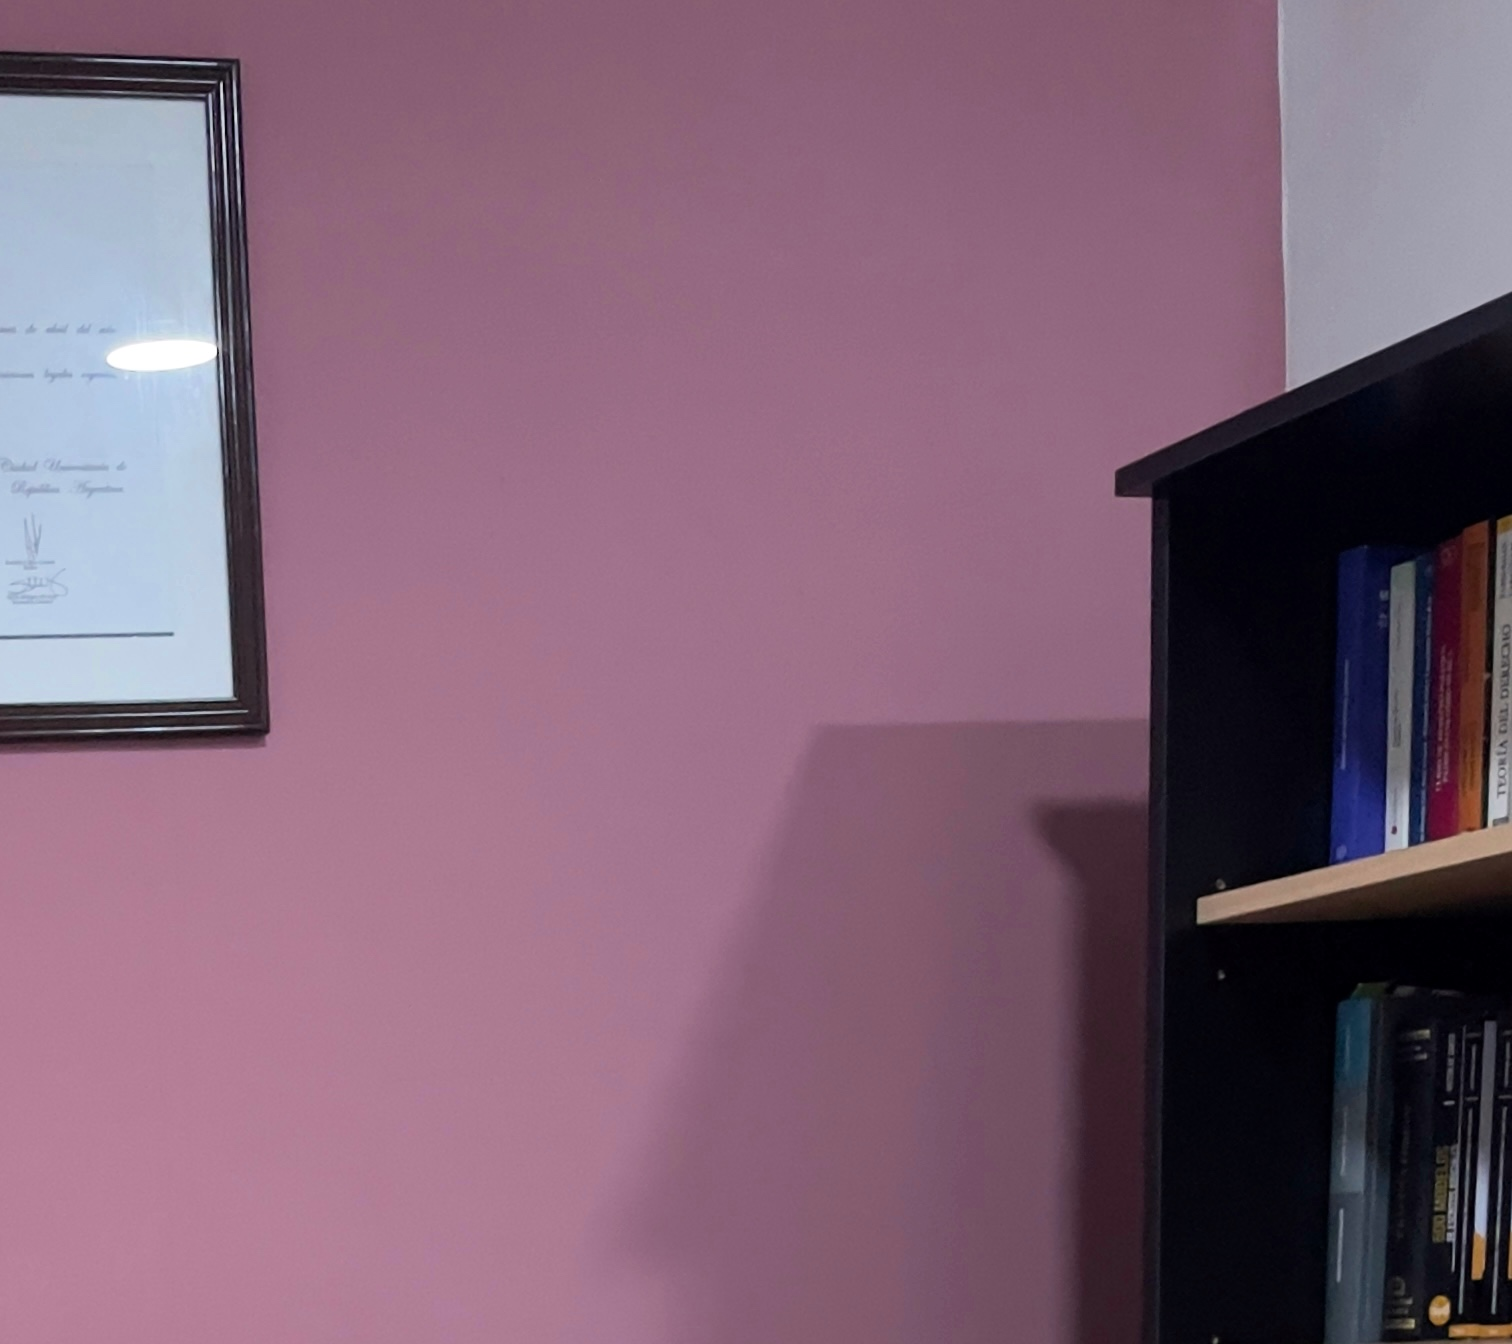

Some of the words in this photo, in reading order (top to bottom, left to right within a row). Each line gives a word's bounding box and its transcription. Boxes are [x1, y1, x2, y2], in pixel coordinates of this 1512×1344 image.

[1499, 624, 1512, 702] DERECHO
[1498, 702, 1509, 736] DEL
[1496, 739, 1508, 800] TEORÍA
